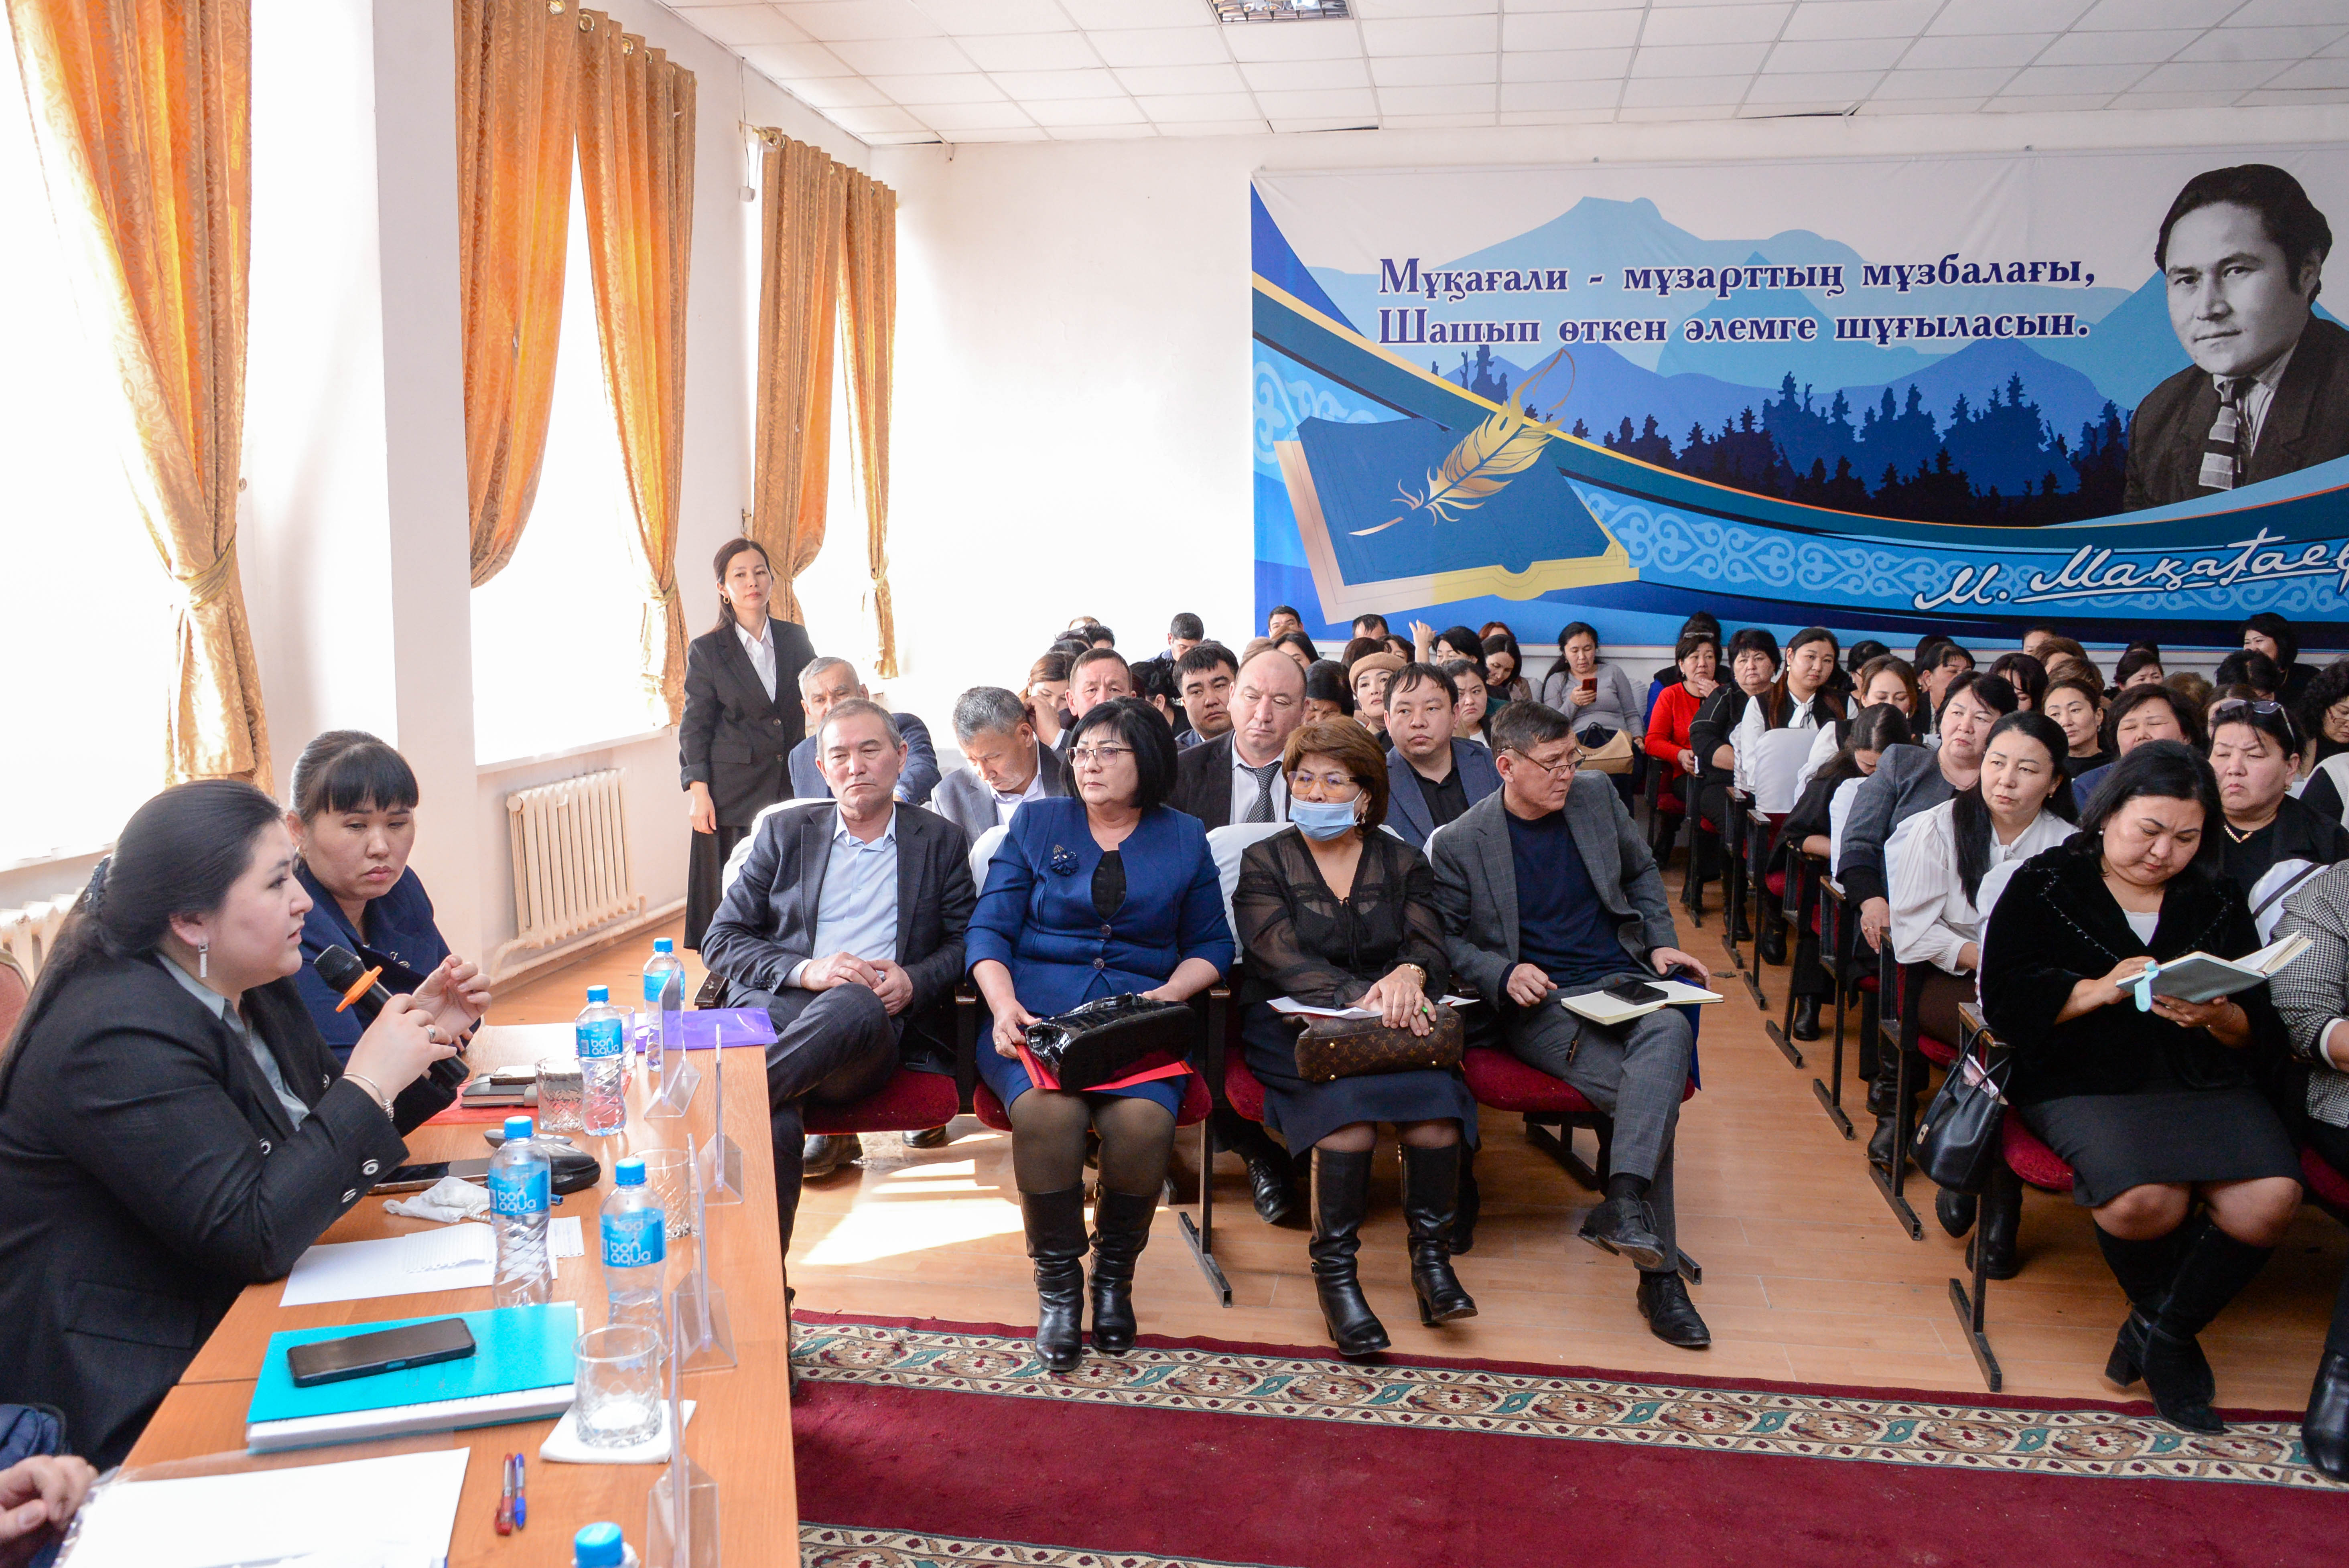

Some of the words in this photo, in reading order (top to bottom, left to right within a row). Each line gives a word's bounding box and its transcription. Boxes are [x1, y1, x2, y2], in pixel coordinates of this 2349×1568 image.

[1380, 258, 1568, 304] Мұқағали
[1624, 267, 1845, 298] мұзарттың
[1862, 253, 2095, 292] мұзбалағы,
[1379, 309, 1540, 343] Шашып
[1559, 321, 1667, 342] өткен
[1686, 319, 1816, 341] әлемге
[1835, 314, 2088, 345] шұғыласын.
[1914, 565, 2010, 610] М.
[591, 1038, 613, 1047] bon
[592, 1045, 619, 1055] aqua
[498, 1189, 527, 1202] bon
[499, 1199, 536, 1213] aqua
[610, 1240, 641, 1253] bon
[611, 1250, 651, 1266] aqua
